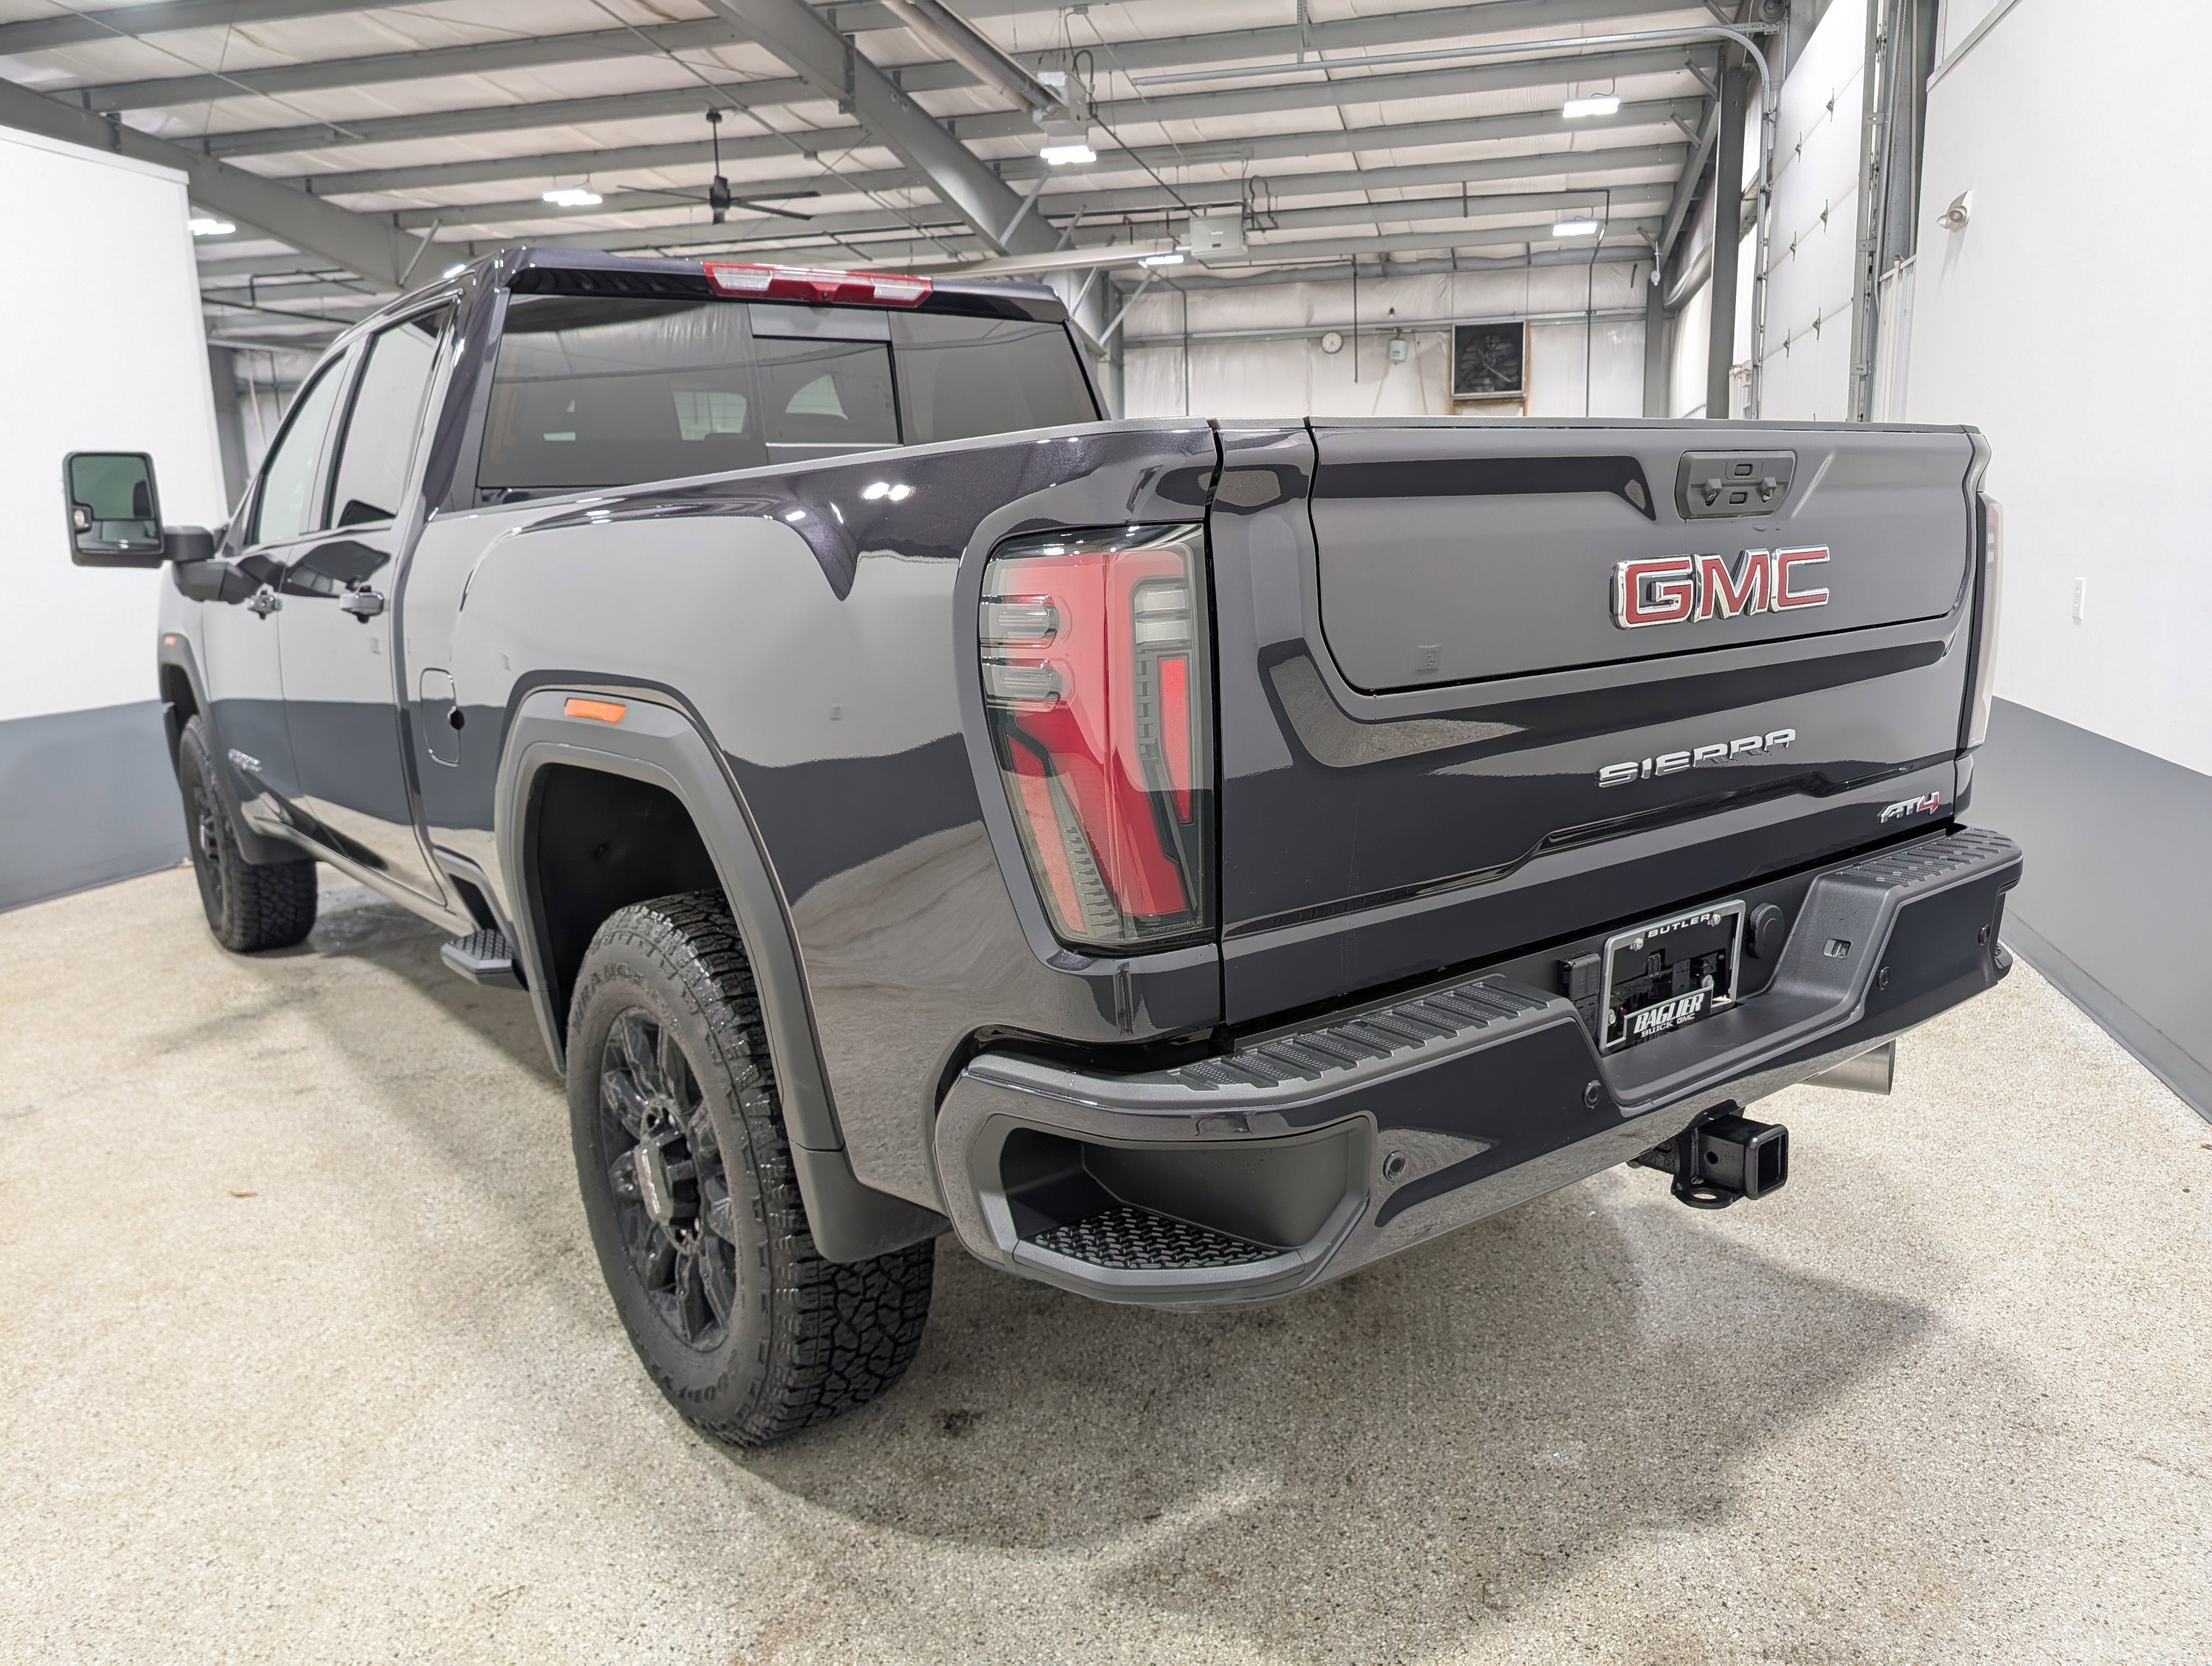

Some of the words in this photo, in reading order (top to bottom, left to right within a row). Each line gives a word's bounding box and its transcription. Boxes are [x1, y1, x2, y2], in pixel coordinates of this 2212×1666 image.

[1610, 544, 1830, 629] GMC
[1596, 728, 1796, 787] SIERRA
[1877, 791, 1940, 823] AT4
[1648, 914, 1711, 938] BUTLER
[1634, 993, 1704, 1034] BAGLIER
[1641, 1022, 1674, 1037] BUICK
[1676, 1014, 1695, 1024] GMC
